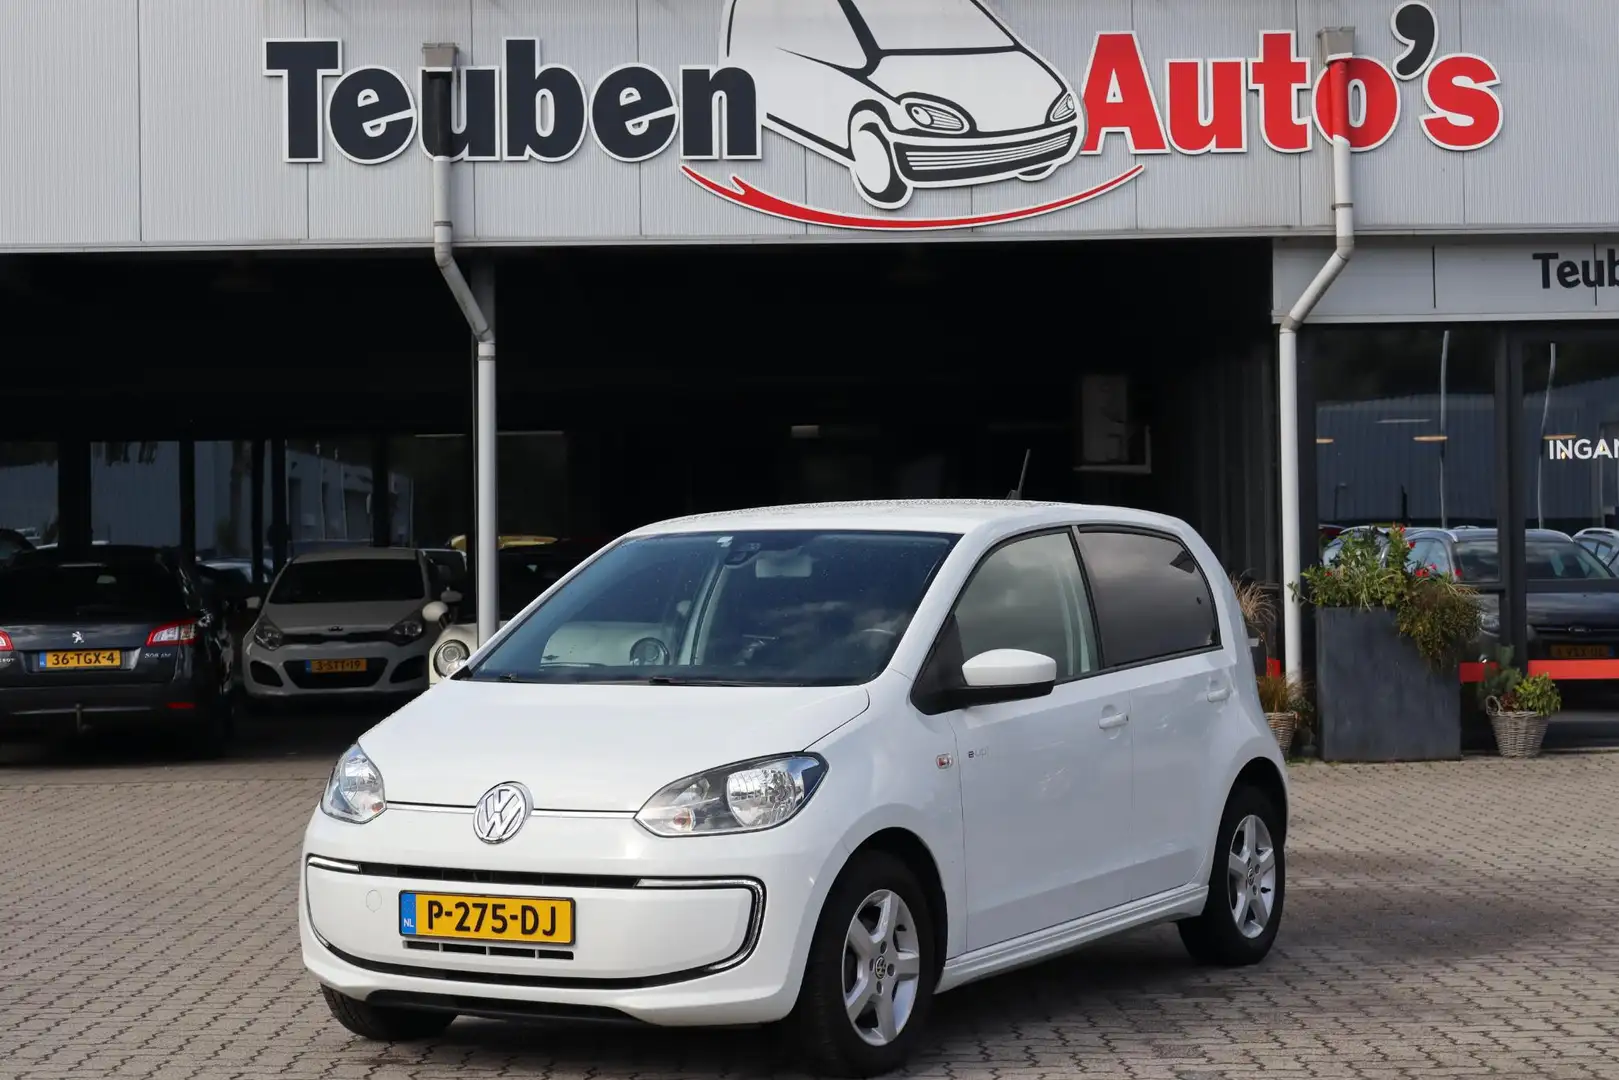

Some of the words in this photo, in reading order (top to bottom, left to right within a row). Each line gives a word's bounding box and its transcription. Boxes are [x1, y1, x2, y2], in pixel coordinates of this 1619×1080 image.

[263, 37, 763, 165] Teuben
[1080, 0, 1503, 155] Auto's
[52, 652, 115, 665] 36-TGX-4
[403, 918, 415, 928] NL
[427, 899, 557, 937] P-275-DJ
